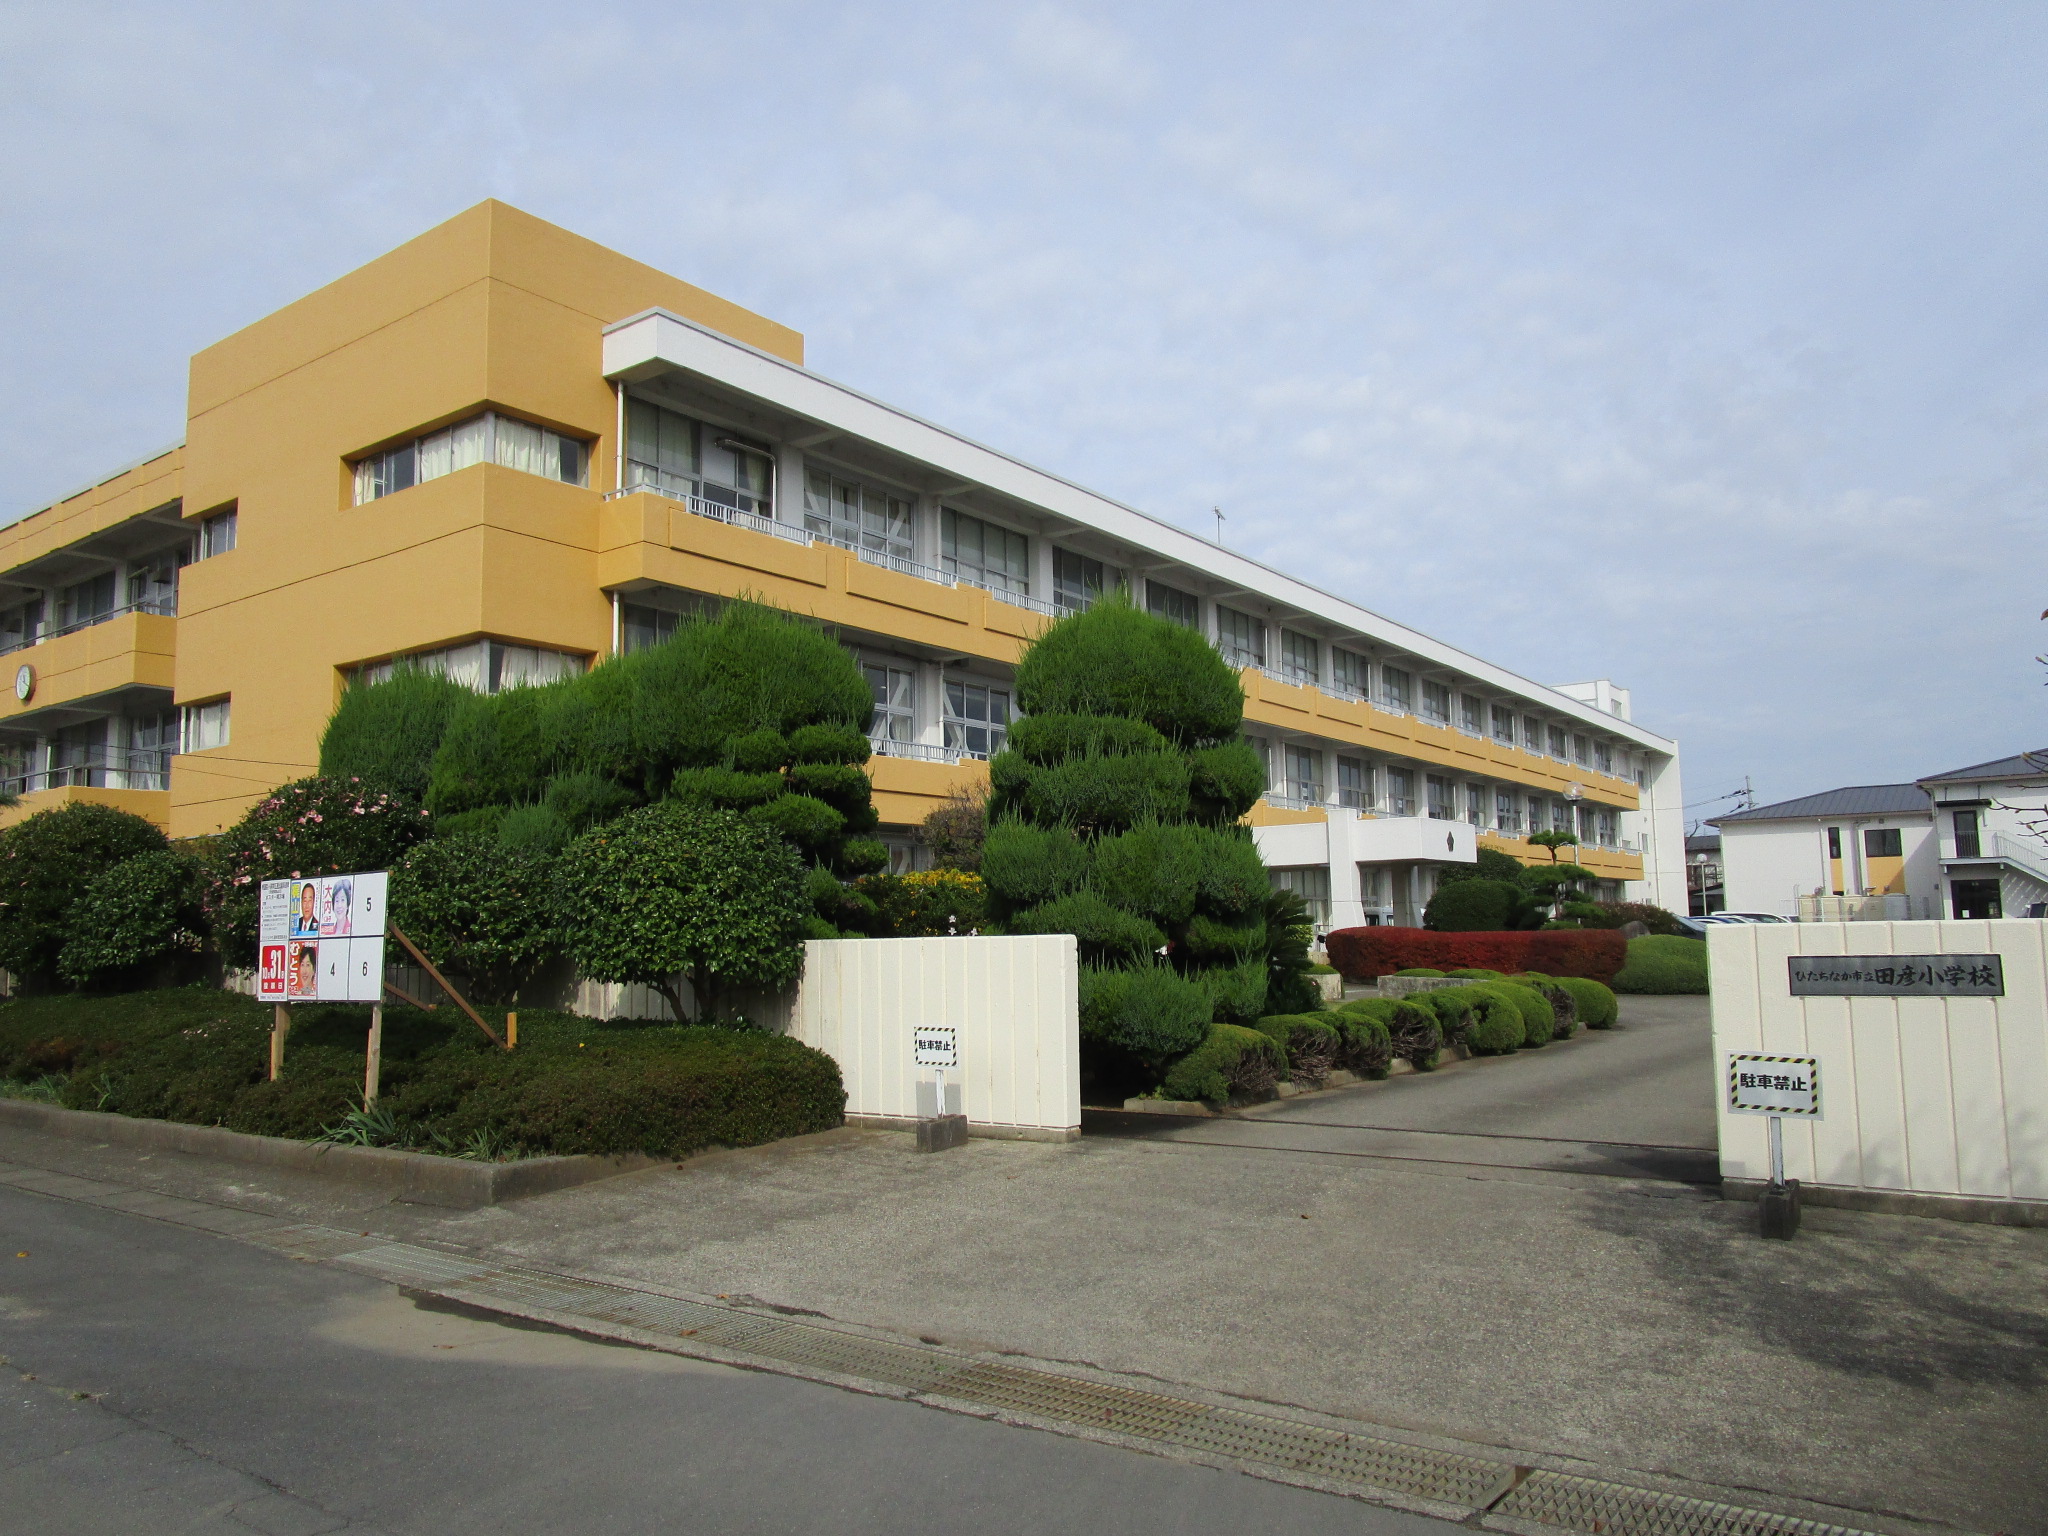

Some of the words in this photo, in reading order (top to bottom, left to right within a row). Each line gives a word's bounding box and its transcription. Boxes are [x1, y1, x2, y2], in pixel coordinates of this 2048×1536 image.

[324, 884, 333, 914] 大内
[366, 897, 372, 912] 5
[289, 942, 301, 986] むとう
[330, 962, 336, 977] 4
[362, 962, 368, 976] 6
[918, 1039, 952, 1051] 駐車禁止
[1740, 1072, 1808, 1092] 駐車禁止
